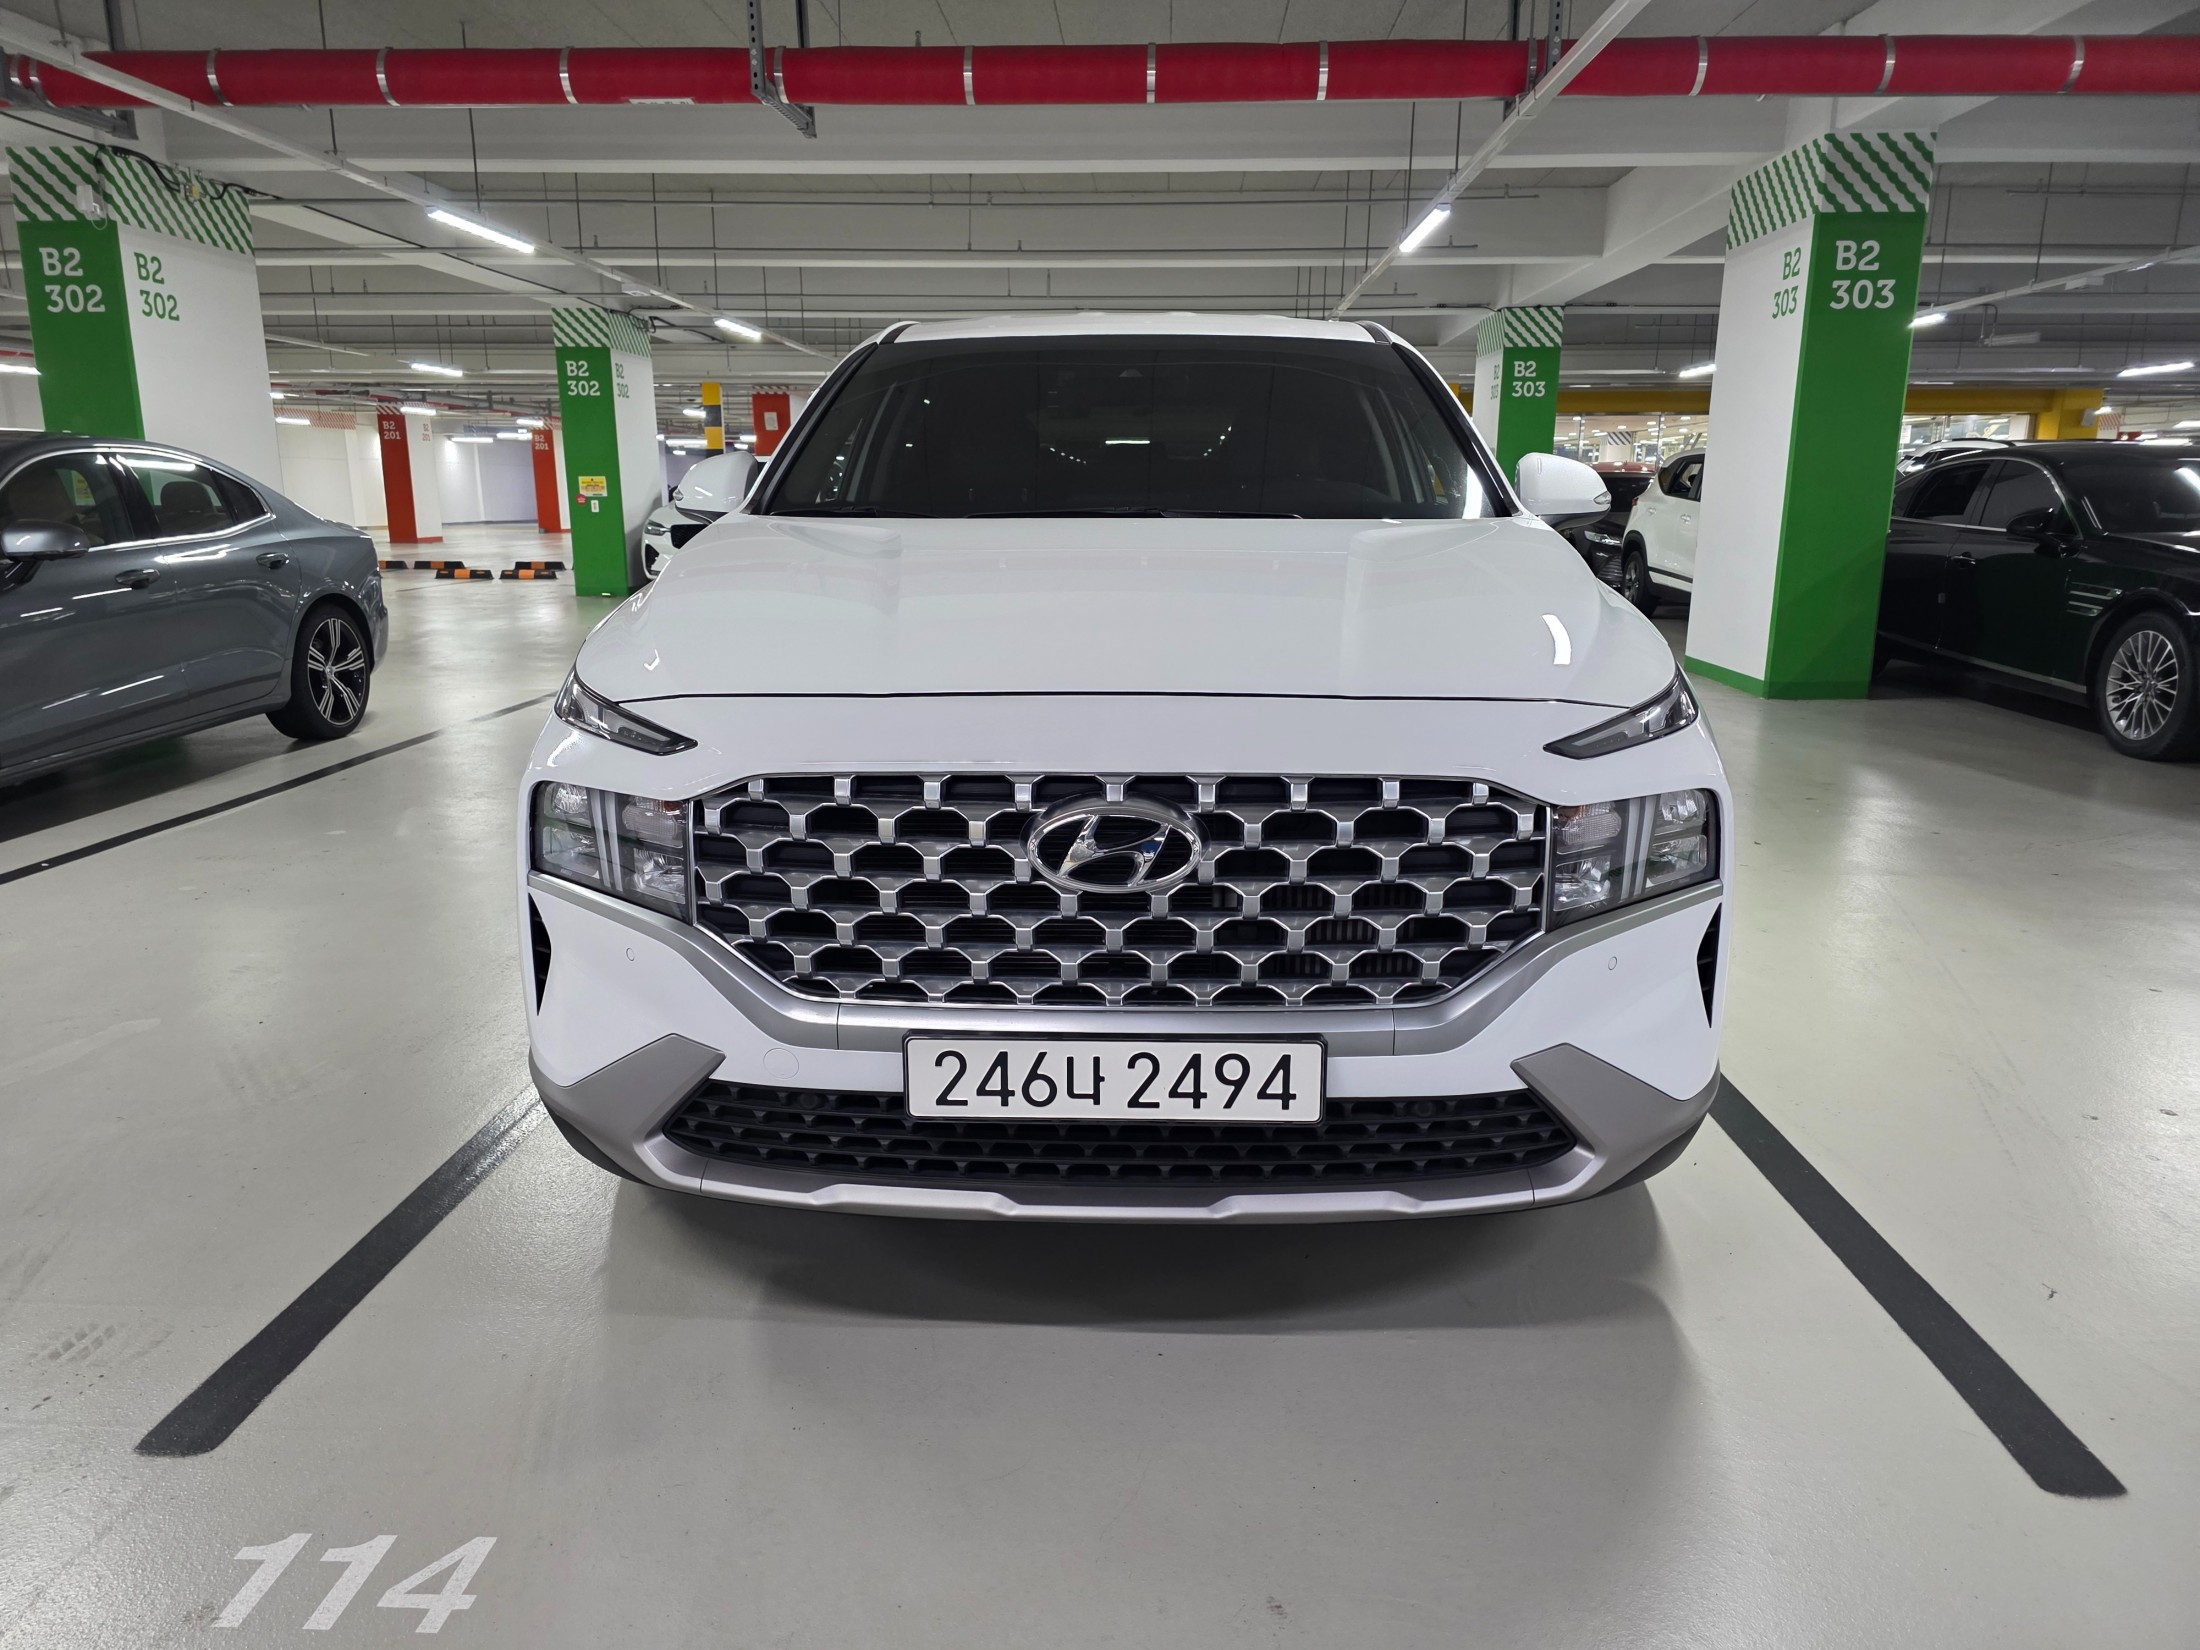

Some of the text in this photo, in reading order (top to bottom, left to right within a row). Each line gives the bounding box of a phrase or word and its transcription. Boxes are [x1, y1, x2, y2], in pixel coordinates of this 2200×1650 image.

[38, 247, 84, 277] B2
[1782, 246, 1802, 281] B2
[1836, 239, 1881, 271] B2
[133, 251, 165, 285] B2
[44, 284, 106, 313] 302
[139, 289, 181, 322] 302
[1771, 285, 1799, 320] 303
[1829, 279, 1897, 310] 303
[565, 360, 590, 377] B2
[615, 362, 625, 380] B2
[1513, 360, 1537, 377] B2
[567, 380, 601, 397] 302
[616, 382, 630, 399] 302
[1511, 380, 1546, 397] 303
[382, 420, 396, 430] B2
[383, 431, 402, 440] 201
[534, 434, 545, 442] B2
[535, 442, 550, 450] 201
[934, 1049, 1298, 1111] 246나 2494
[209, 1532, 498, 1634] 114
